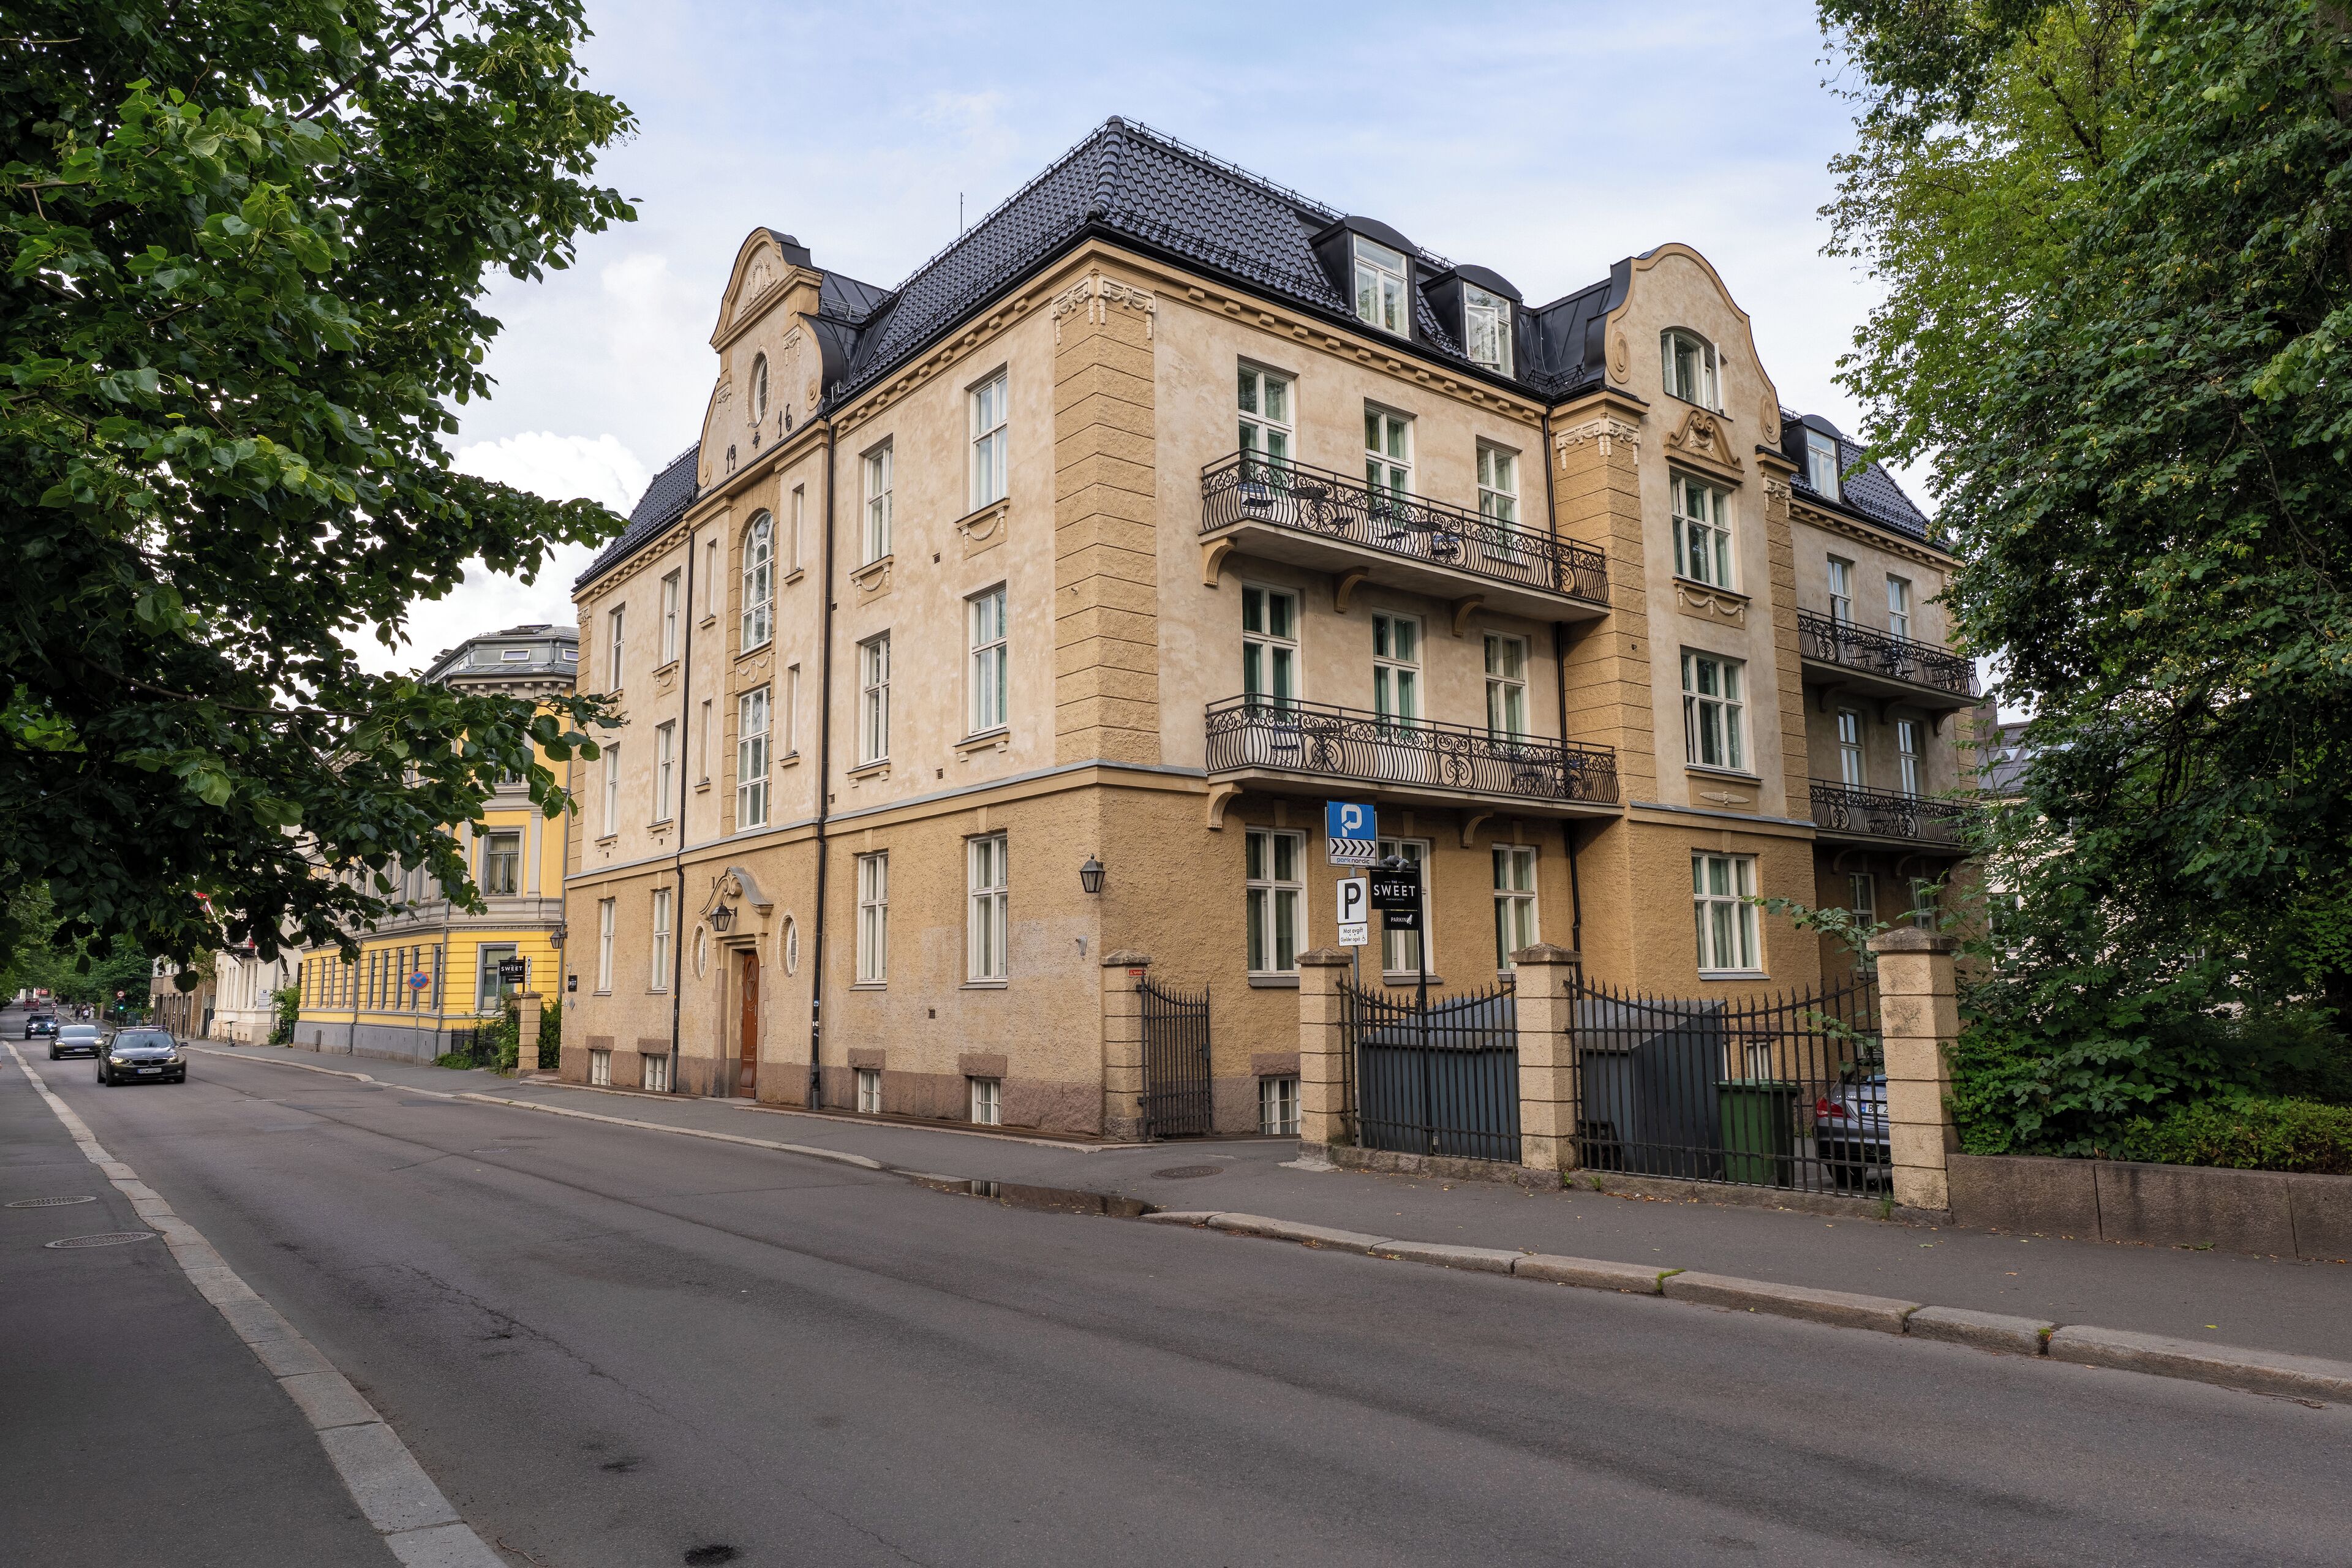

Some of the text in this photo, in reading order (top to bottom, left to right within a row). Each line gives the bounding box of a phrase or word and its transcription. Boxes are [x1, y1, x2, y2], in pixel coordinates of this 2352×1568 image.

[1373, 884, 1415, 897] SWEET
[1344, 883, 1361, 919] P
[1352, 926, 1363, 935] avgift
